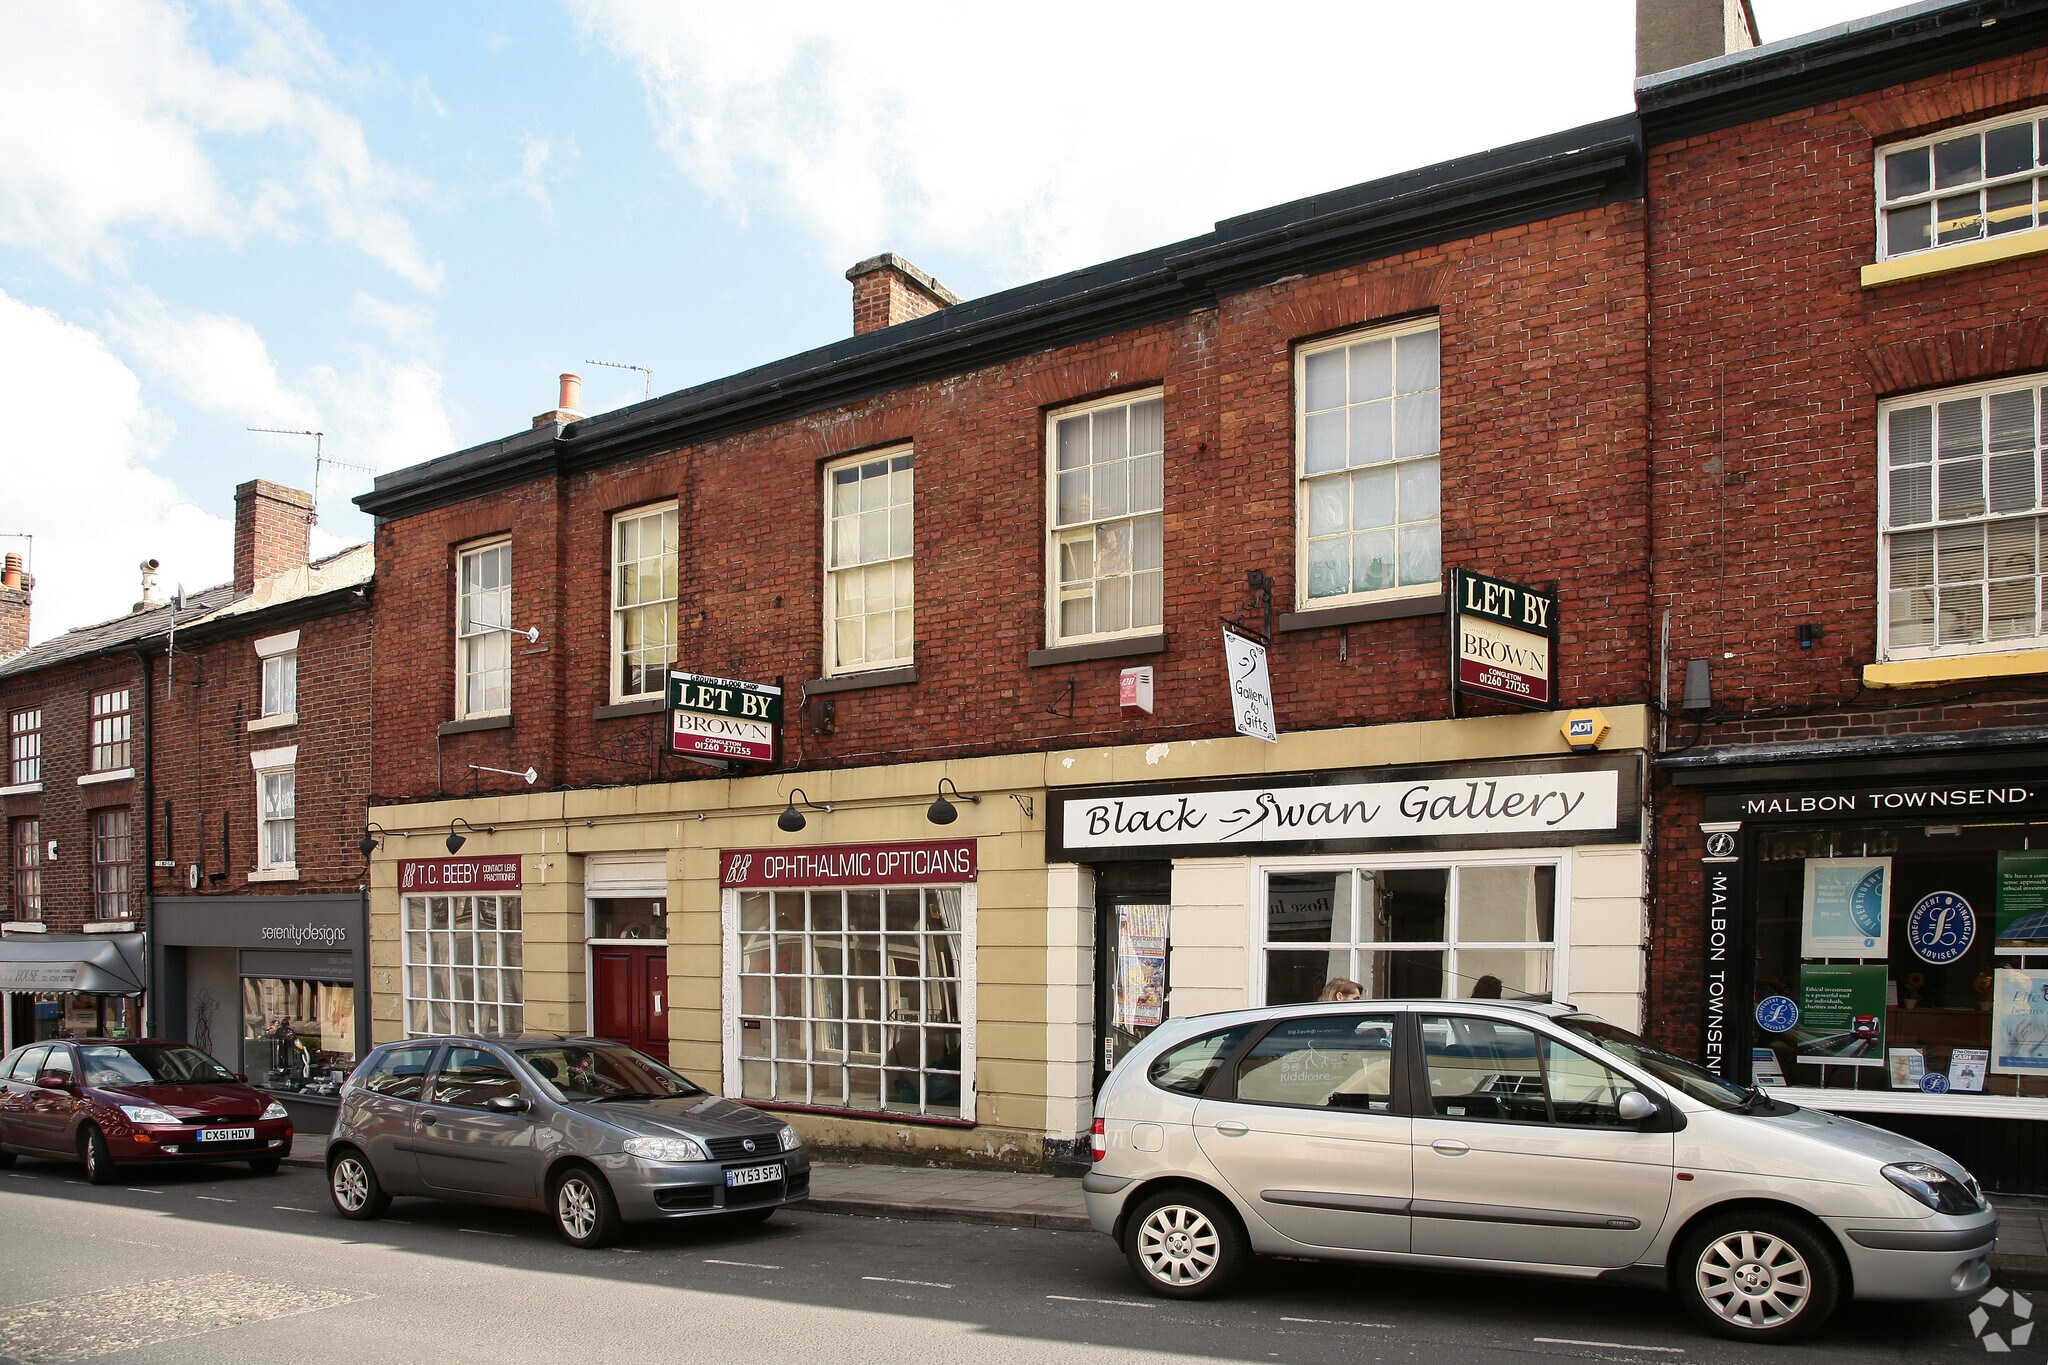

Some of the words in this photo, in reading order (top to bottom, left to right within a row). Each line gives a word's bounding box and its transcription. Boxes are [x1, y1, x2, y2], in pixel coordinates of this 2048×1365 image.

[1466, 577, 1515, 619] LET
[1522, 592, 1551, 629] BY
[1464, 633, 1545, 673] BROWN
[690, 674, 718, 685] GROUND
[721, 680, 742, 689] FLOOR
[743, 682, 760, 691] SHOP
[1479, 672, 1502, 687] 01260
[1505, 679, 1531, 694] 271255
[1488, 668, 1522, 681] CONGLETON
[678, 682, 733, 712] LET
[741, 692, 773, 719] BY
[1235, 679, 1270, 711] Gallery
[678, 714, 768, 740] BROWN
[1244, 710, 1268, 733] Gifts
[1570, 722, 1593, 733] ADT
[694, 742, 720, 752] 01260
[723, 745, 751, 756] 271255
[704, 737, 742, 747] CONGLETON
[1086, 797, 1208, 836] Black
[1219, 792, 1381, 841] Swan
[1400, 781, 1586, 826] Gallery
[1748, 795, 1856, 814] MALBON
[1868, 787, 2027, 809] TOWNSEND
[417, 864, 439, 884] T.C.
[443, 863, 480, 884] BEEBY
[482, 864, 504, 872] CONTACT
[504, 863, 517, 872] LENS
[764, 852, 871, 879] OPHTHALMIC
[876, 848, 970, 875] OPTICIANS
[1855, 873, 1881, 930] INDEPENDENT
[1710, 876, 1728, 961] MALBON
[1911, 896, 1940, 945] INDEPENDENT
[1955, 902, 1972, 946] FINANCIAL
[1920, 947, 1958, 960] ADVISER
[2012, 990, 2040, 1003] Life
[2011, 1006, 2043, 1016] begins
[205, 1130, 229, 1140] CX51
[231, 1129, 250, 1139] HDV
[734, 1168, 761, 1184] YY53
[762, 1165, 781, 1180] SFX
